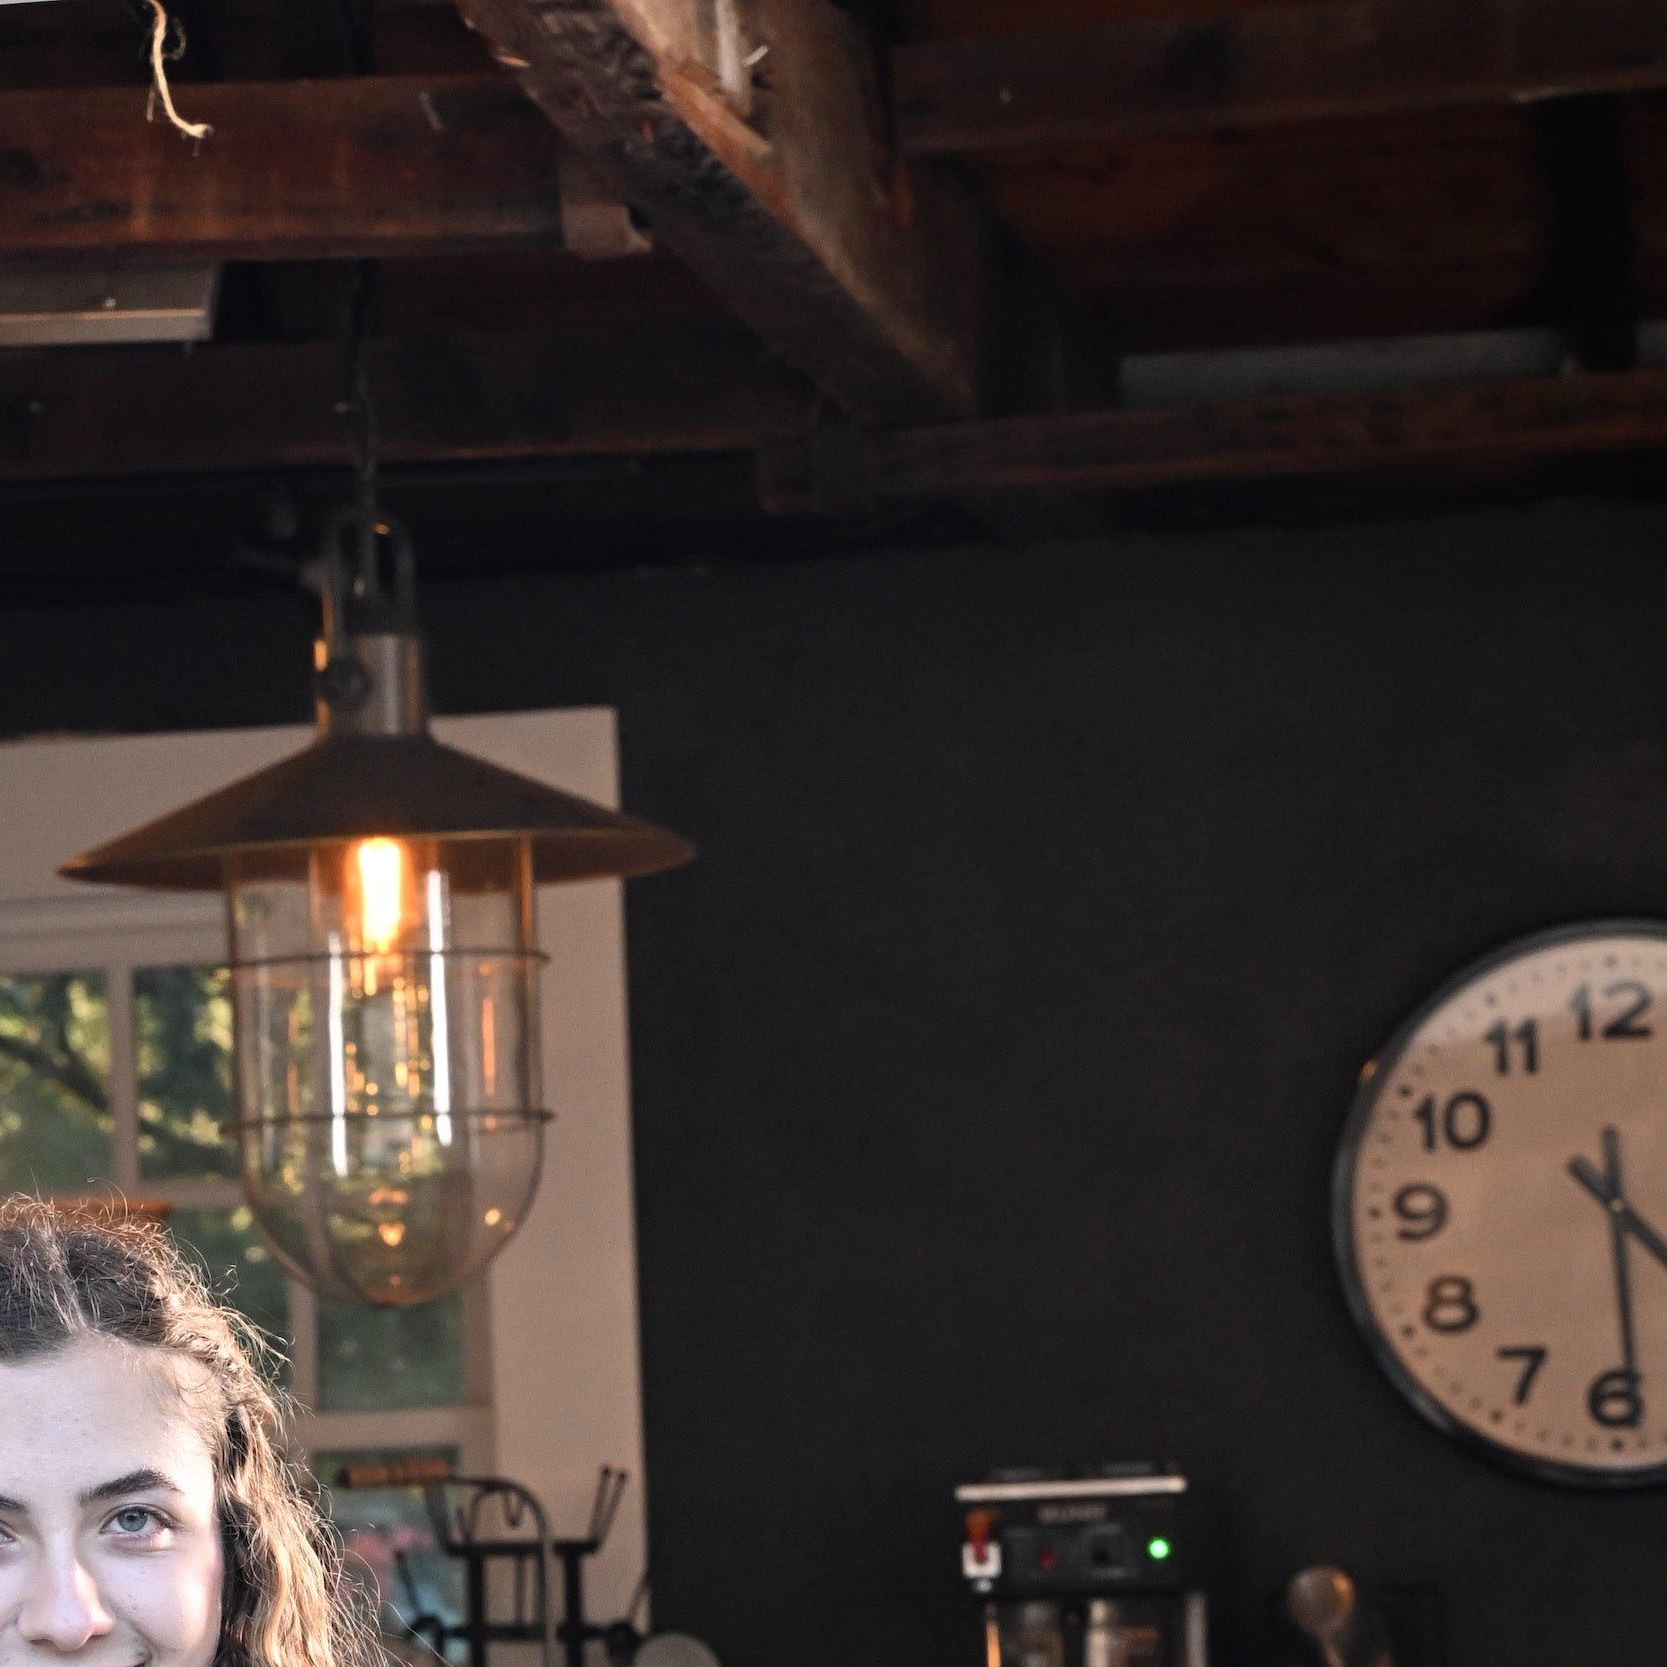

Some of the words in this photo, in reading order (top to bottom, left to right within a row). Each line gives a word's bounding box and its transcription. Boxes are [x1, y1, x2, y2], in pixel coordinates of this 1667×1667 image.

[1570, 981, 1654, 1041] 12
[1485, 1015, 1540, 1076] 11
[1414, 1090, 1492, 1153] 10
[1394, 1183, 1449, 1242] 9
[1422, 1274, 1480, 1334] 8
[1496, 1345, 1548, 1405] 7
[1587, 1368, 1645, 1428] 6
